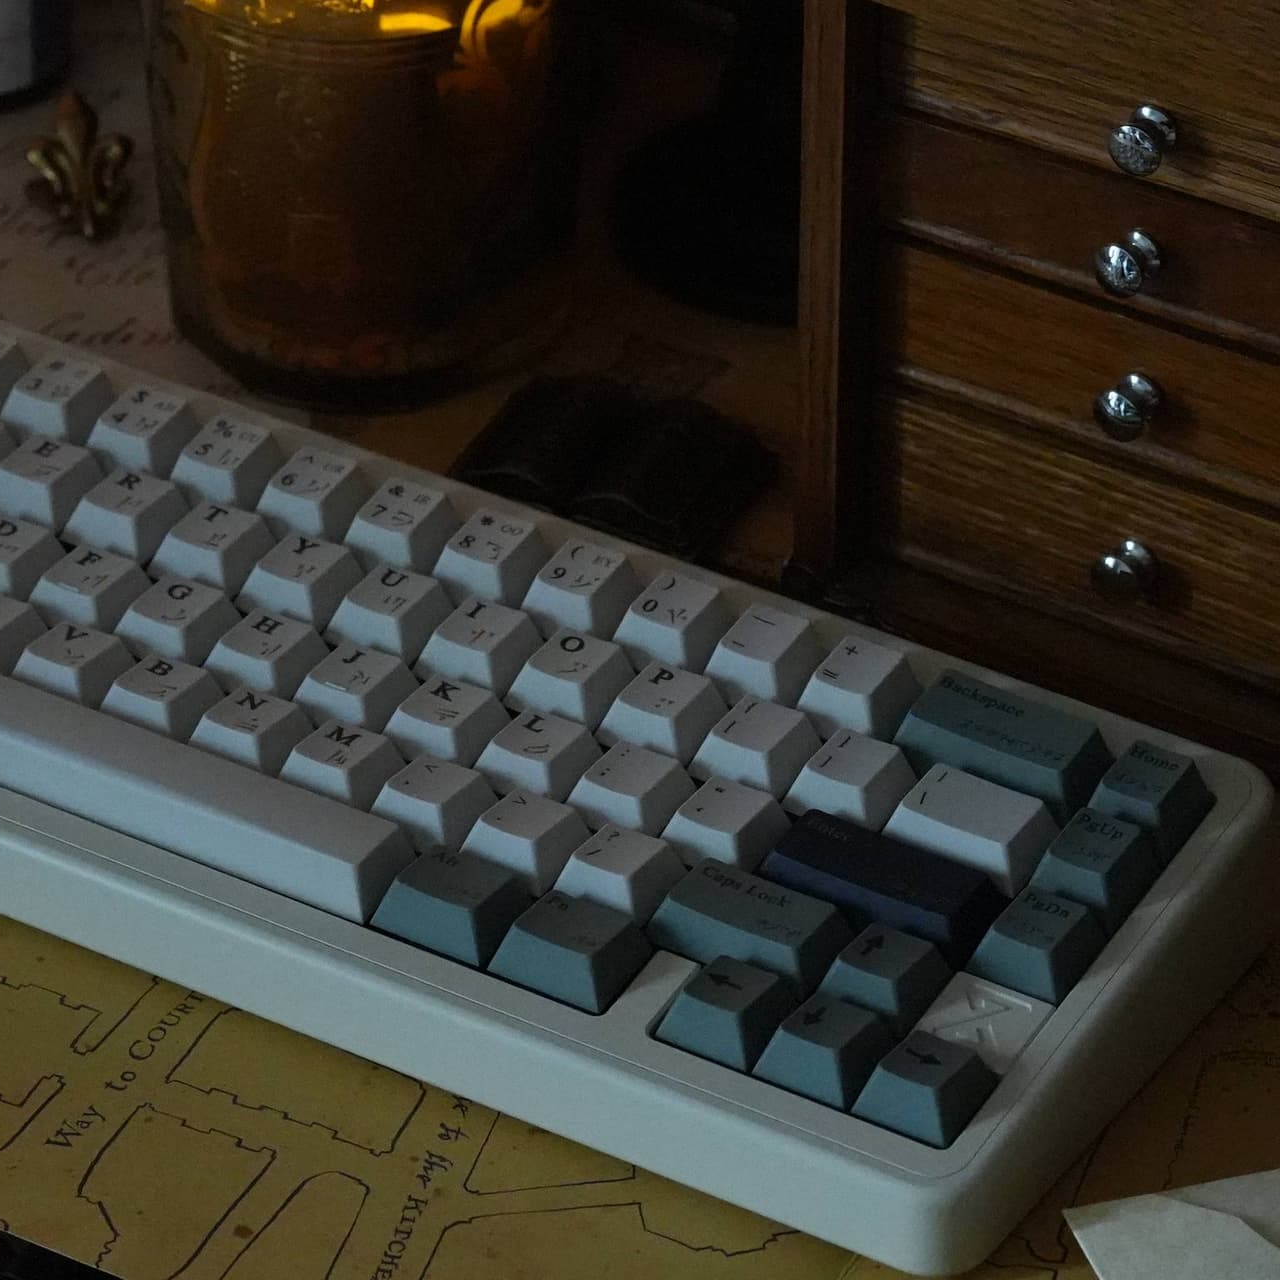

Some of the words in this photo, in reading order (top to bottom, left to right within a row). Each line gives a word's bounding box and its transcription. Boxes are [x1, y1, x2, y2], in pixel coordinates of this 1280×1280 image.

[33, 441, 59, 458] E
[116, 473, 141, 490] R
[206, 505, 228, 522] T
[292, 536, 318, 554] Y
[76, 551, 102, 567] F
[380, 569, 408, 587] U
[167, 584, 193, 601] G
[466, 602, 487, 620] I
[63, 625, 89, 641] V
[252, 616, 283, 634] H
[559, 635, 585, 653] O
[341, 650, 365, 665] J
[145, 660, 174, 676] B
[648, 668, 675, 686] P
[429, 680, 460, 703] K
[939, 676, 1026, 719] Backspace
[236, 691, 267, 711] N
[523, 714, 545, 734] L
[325, 725, 362, 748] M
[1128, 742, 1182, 771] Home
[702, 866, 743, 891] Caps
[43, 1105, 107, 1148] Way
[104, 1071, 137, 1092] to
[437, 1122, 472, 1141] to
[416, 1150, 454, 1190] the
